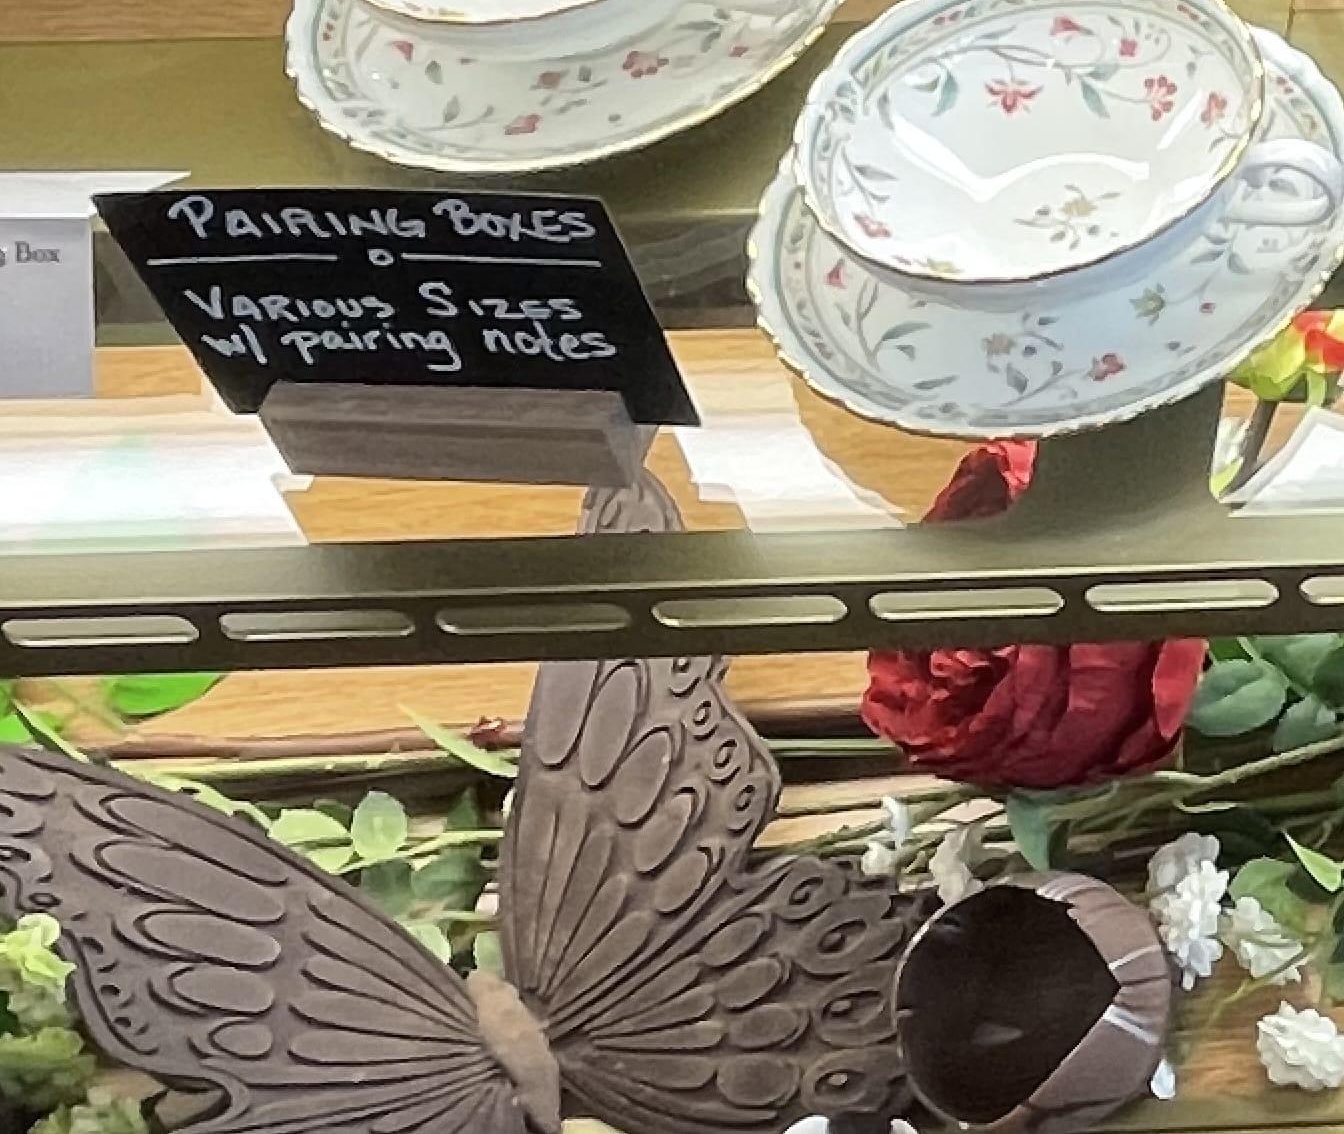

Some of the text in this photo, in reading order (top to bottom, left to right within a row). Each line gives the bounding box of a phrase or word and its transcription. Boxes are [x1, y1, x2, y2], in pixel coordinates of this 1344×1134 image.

[167, 195, 596, 240] PAIRING BOXES
[15, 241, 60, 263] Box
[201, 323, 618, 372] w/ pairing notes
